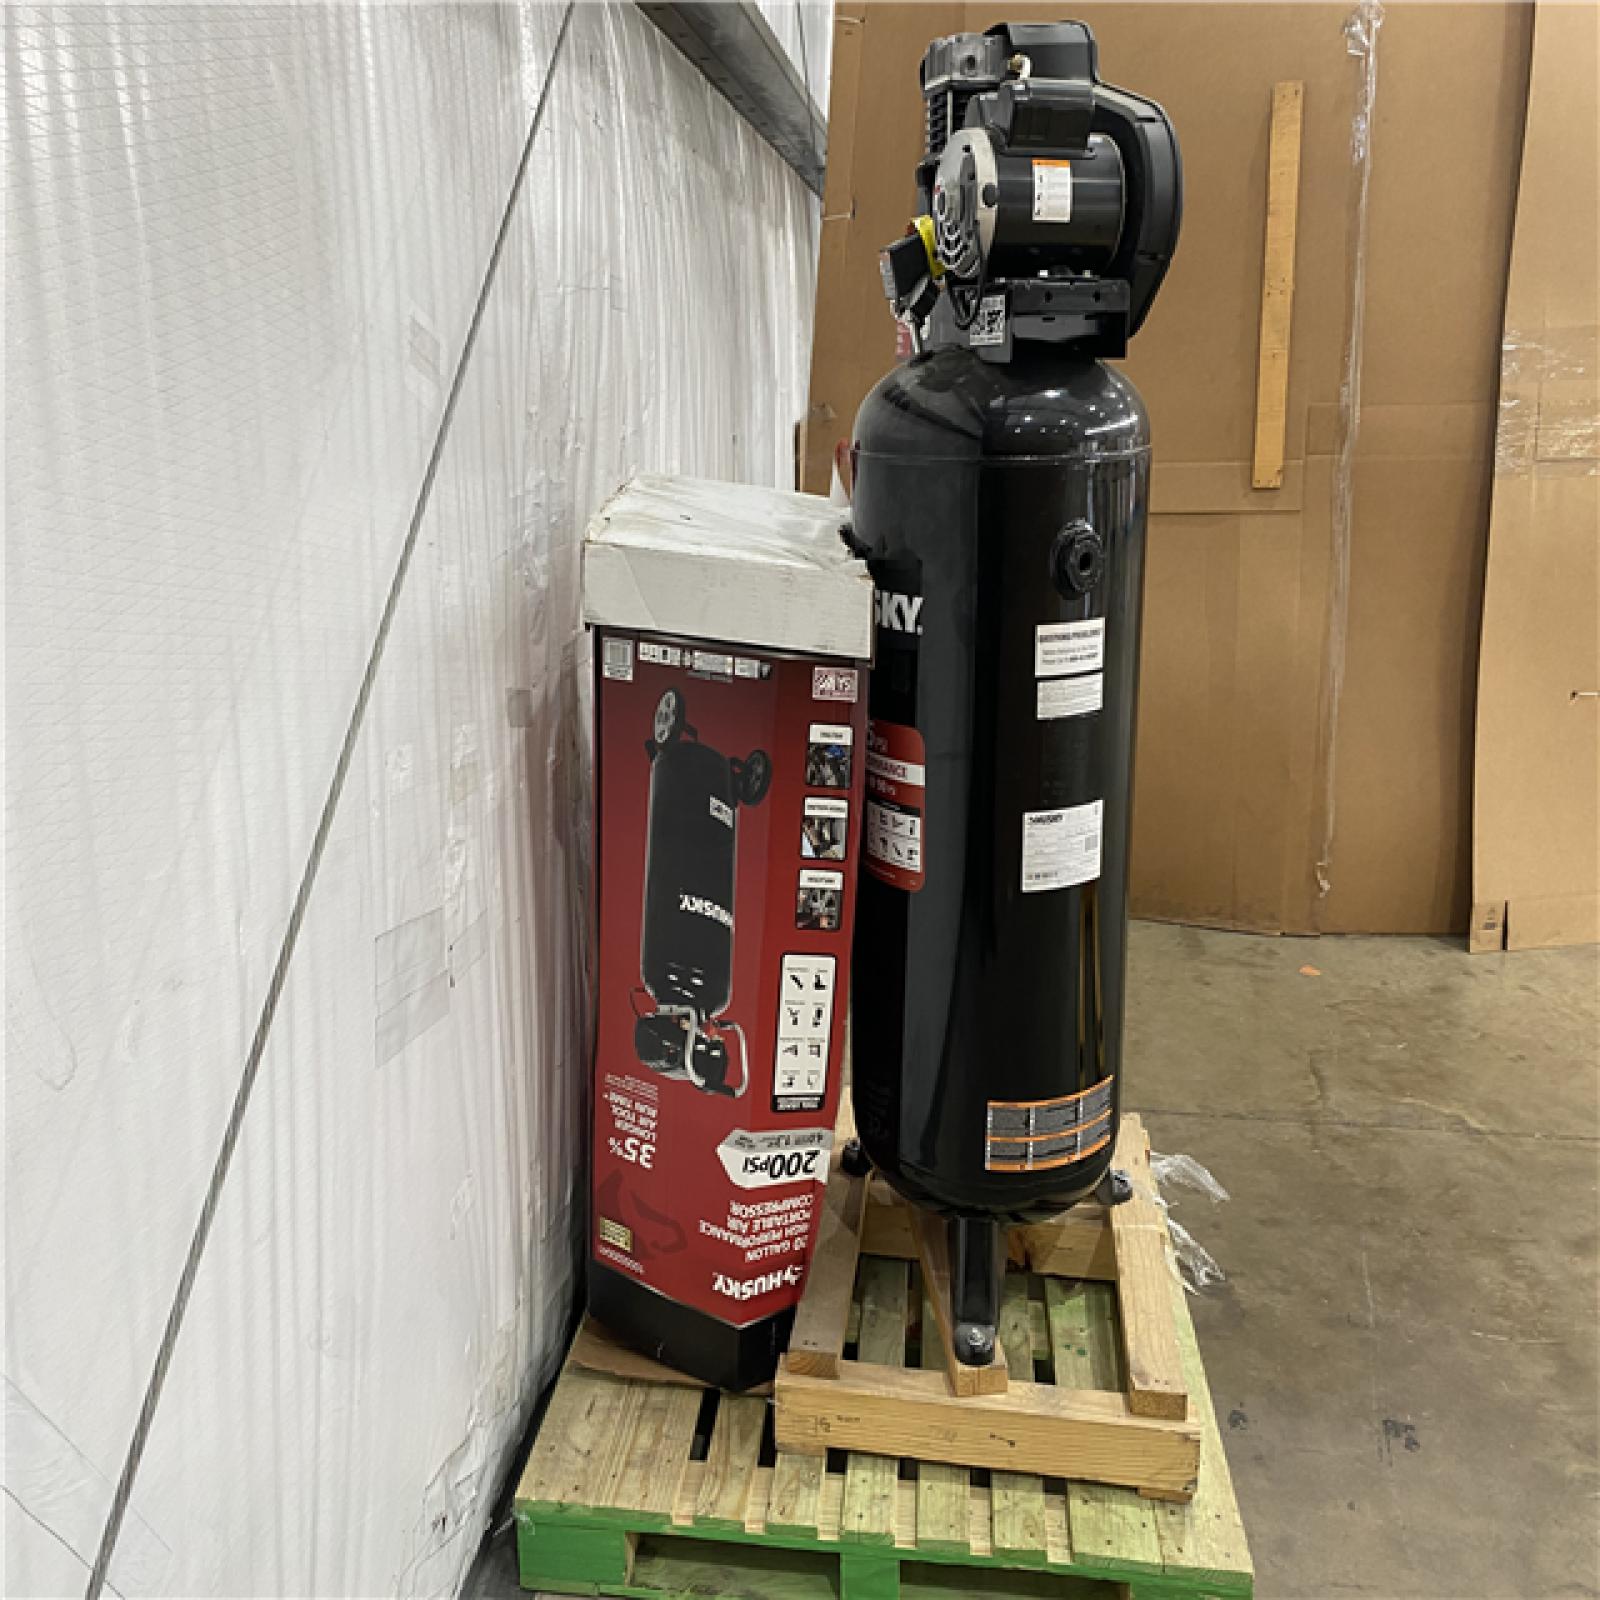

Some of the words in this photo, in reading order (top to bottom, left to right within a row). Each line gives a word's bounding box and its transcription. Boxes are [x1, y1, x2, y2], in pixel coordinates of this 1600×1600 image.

[608, 1136, 656, 1169] 35%
[729, 1194, 813, 1218] COMPRESSOR
[751, 1209, 811, 1232] PORTABLE
[699, 1219, 782, 1248] PERFORMANCE
[712, 1269, 782, 1301] HUSKY
